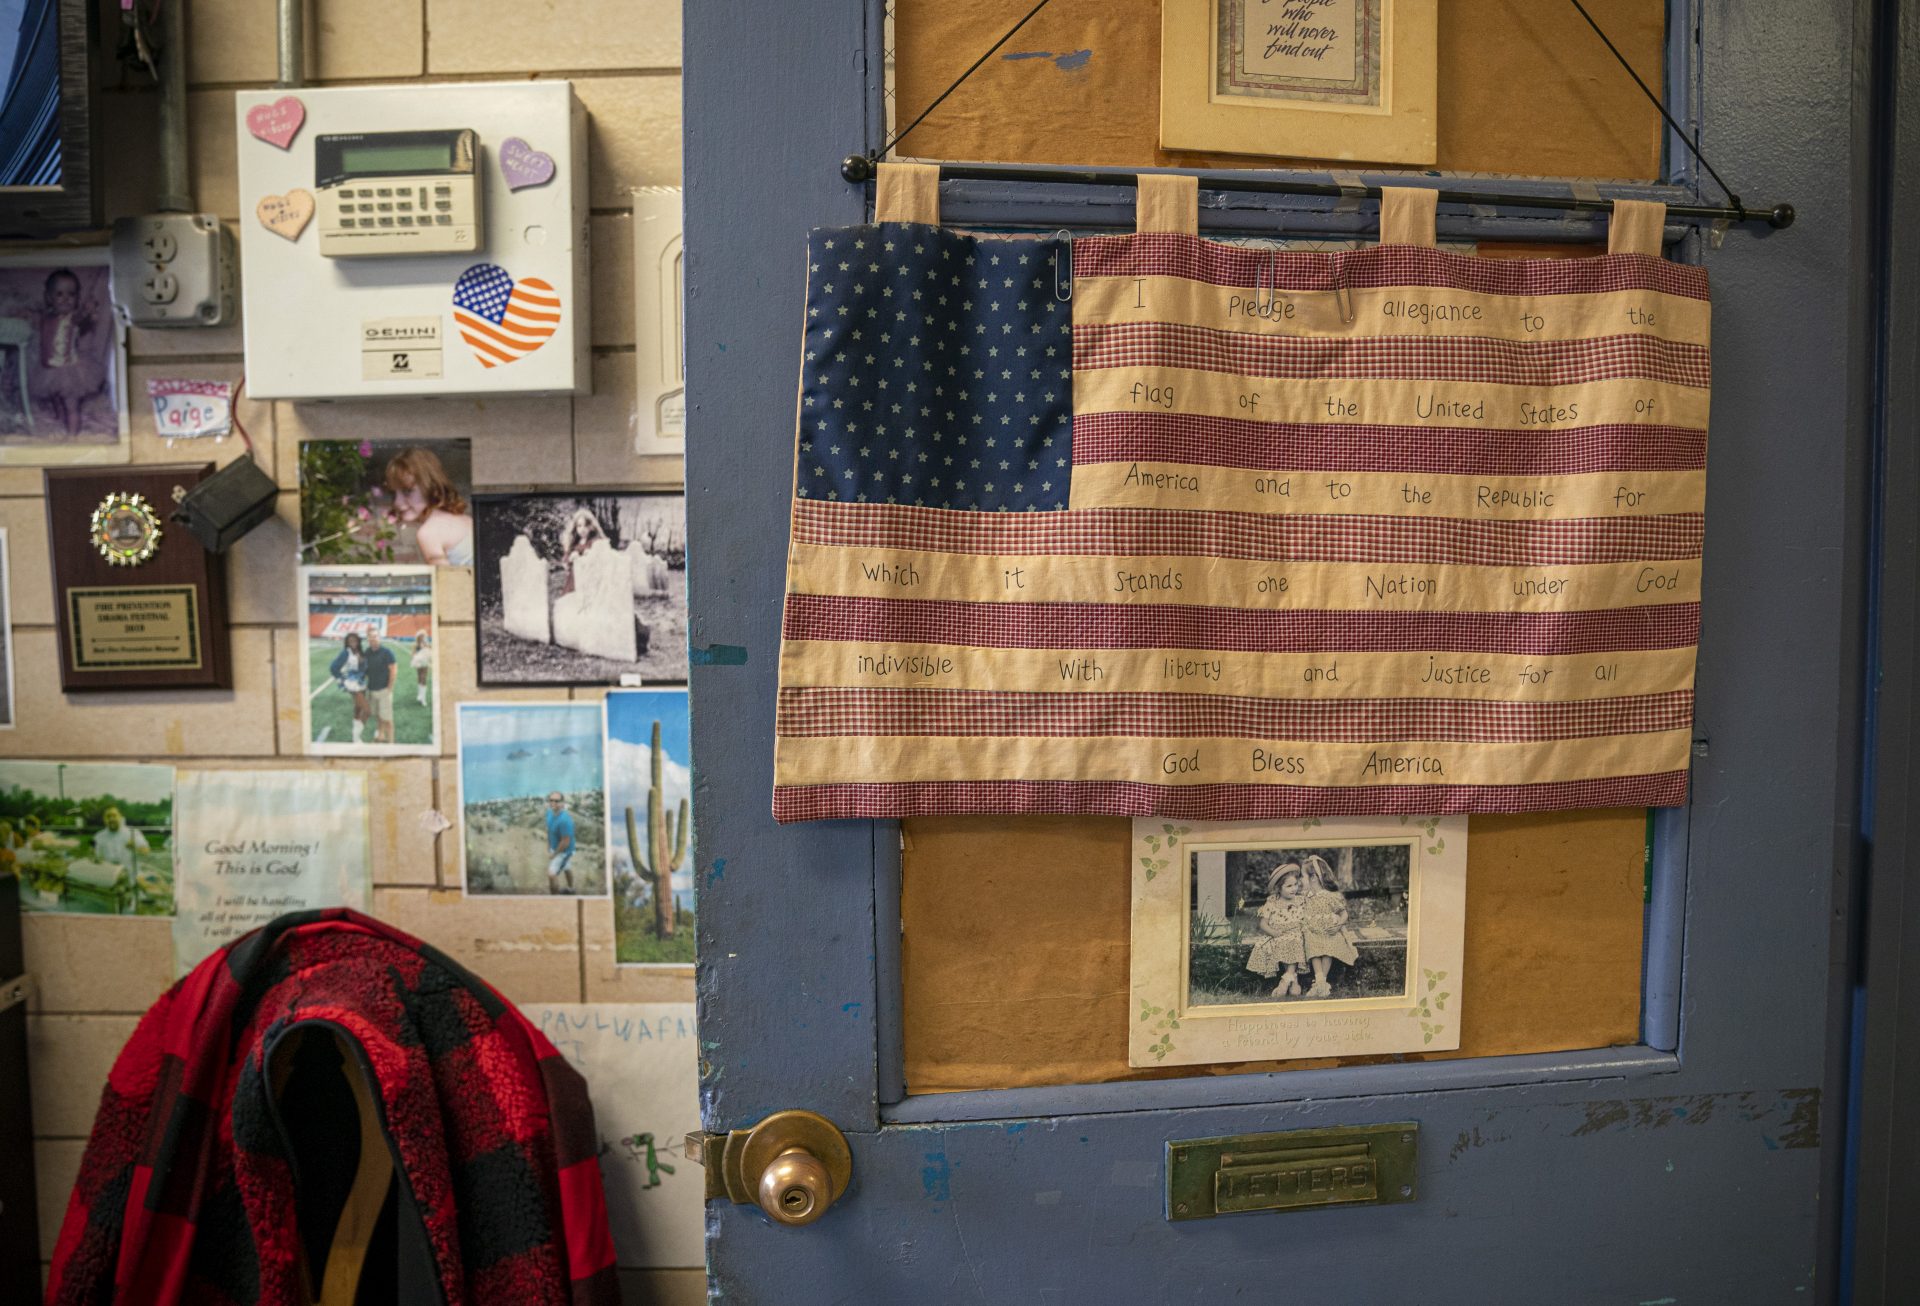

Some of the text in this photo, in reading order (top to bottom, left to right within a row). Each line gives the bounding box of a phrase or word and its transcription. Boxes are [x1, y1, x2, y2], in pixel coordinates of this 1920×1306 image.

[1282, 5, 1315, 21] who
[1267, 22, 1339, 41] will never
[1264, 37, 1305, 59] find
[1133, 278, 1656, 333] I Pledge allegiance to the
[153, 396, 214, 429] Paige
[1130, 382, 1656, 425] flag of the United States of
[1124, 463, 1646, 509] America and to the Republic for
[862, 561, 1680, 600] Which it Stands one Nation under God
[858, 654, 953, 677] indivisible
[1059, 658, 1104, 681] With
[1164, 658, 1221, 681] liberty
[1303, 661, 1338, 682] and
[1518, 664, 1553, 685] for
[1595, 663, 1618, 681] all
[1163, 748, 1444, 776] God Bless America
[204, 839, 246, 855] Good
[248, 840, 312, 857] Morning
[214, 860, 247, 875] This
[251, 861, 262, 875] is
[1227, 1164, 1368, 1198] LETTERS
